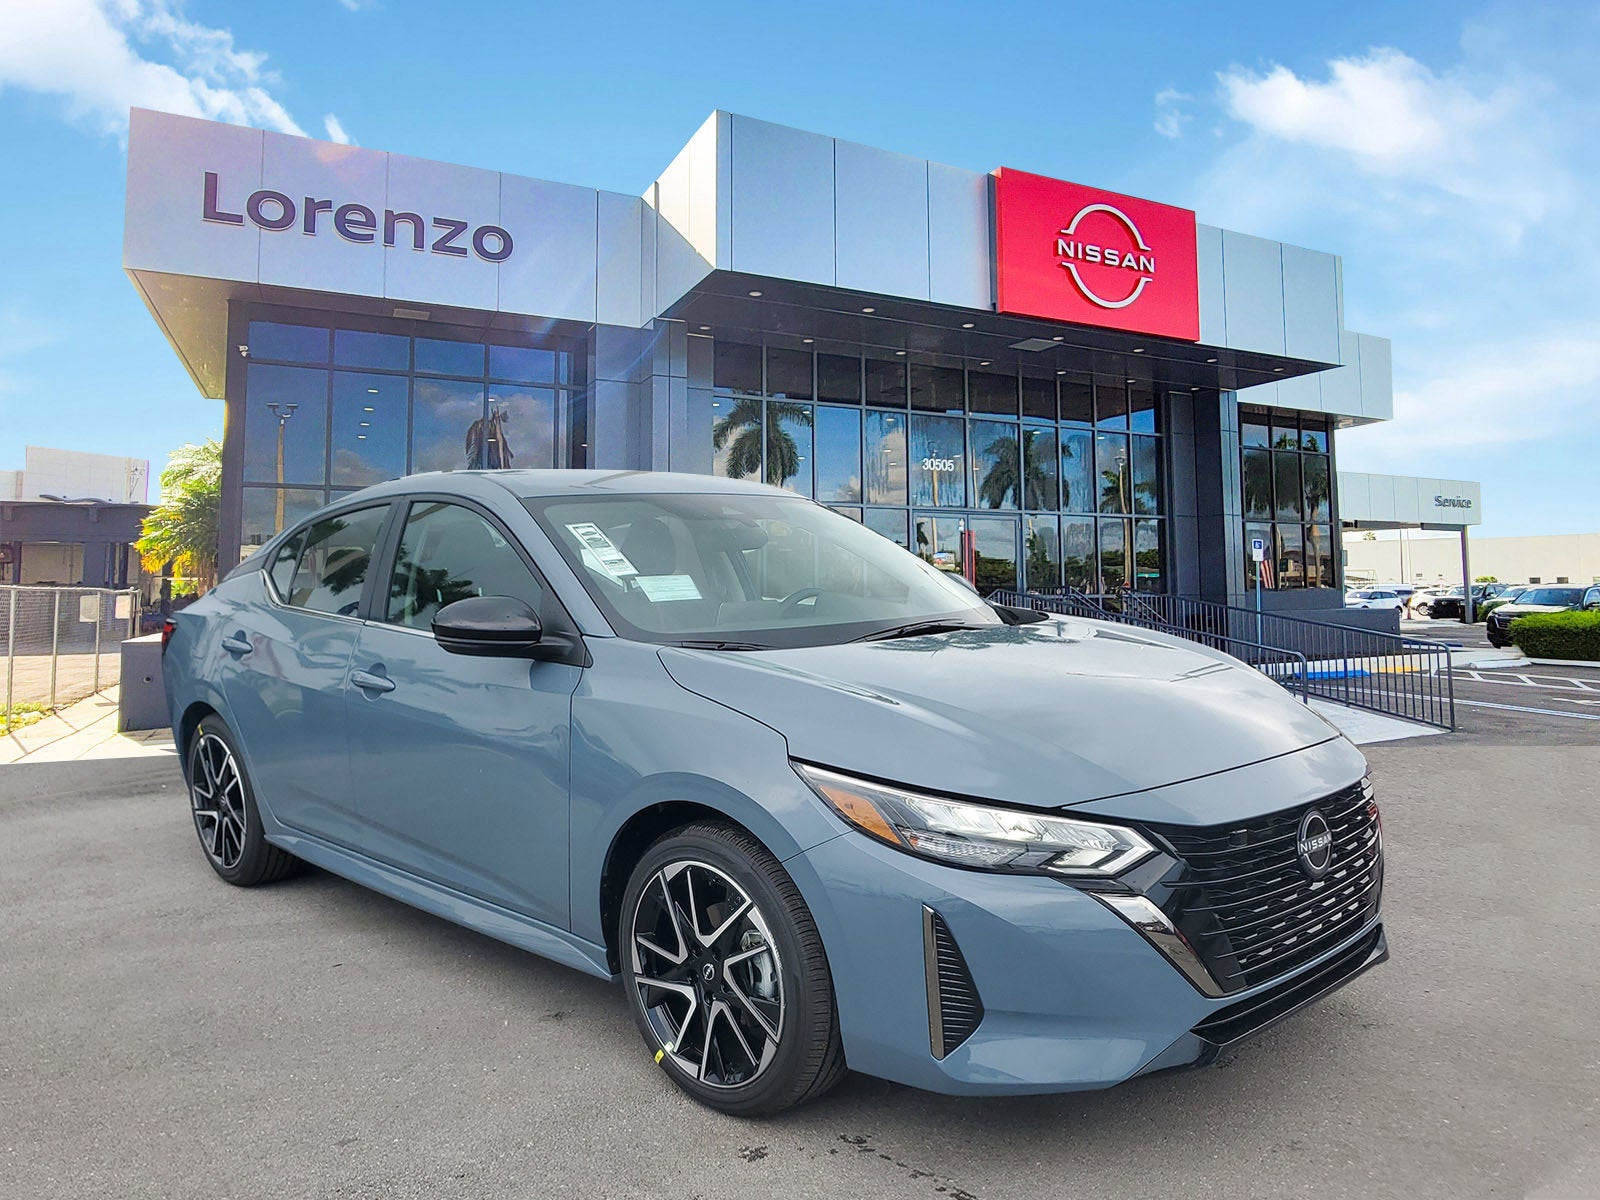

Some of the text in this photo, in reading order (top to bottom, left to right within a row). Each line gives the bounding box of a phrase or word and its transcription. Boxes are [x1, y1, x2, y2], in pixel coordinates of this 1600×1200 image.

[203, 171, 514, 262] Lorenzo
[1057, 238, 1155, 273] NISSAN
[922, 458, 955, 472] 30505
[1434, 495, 1472, 509] Service
